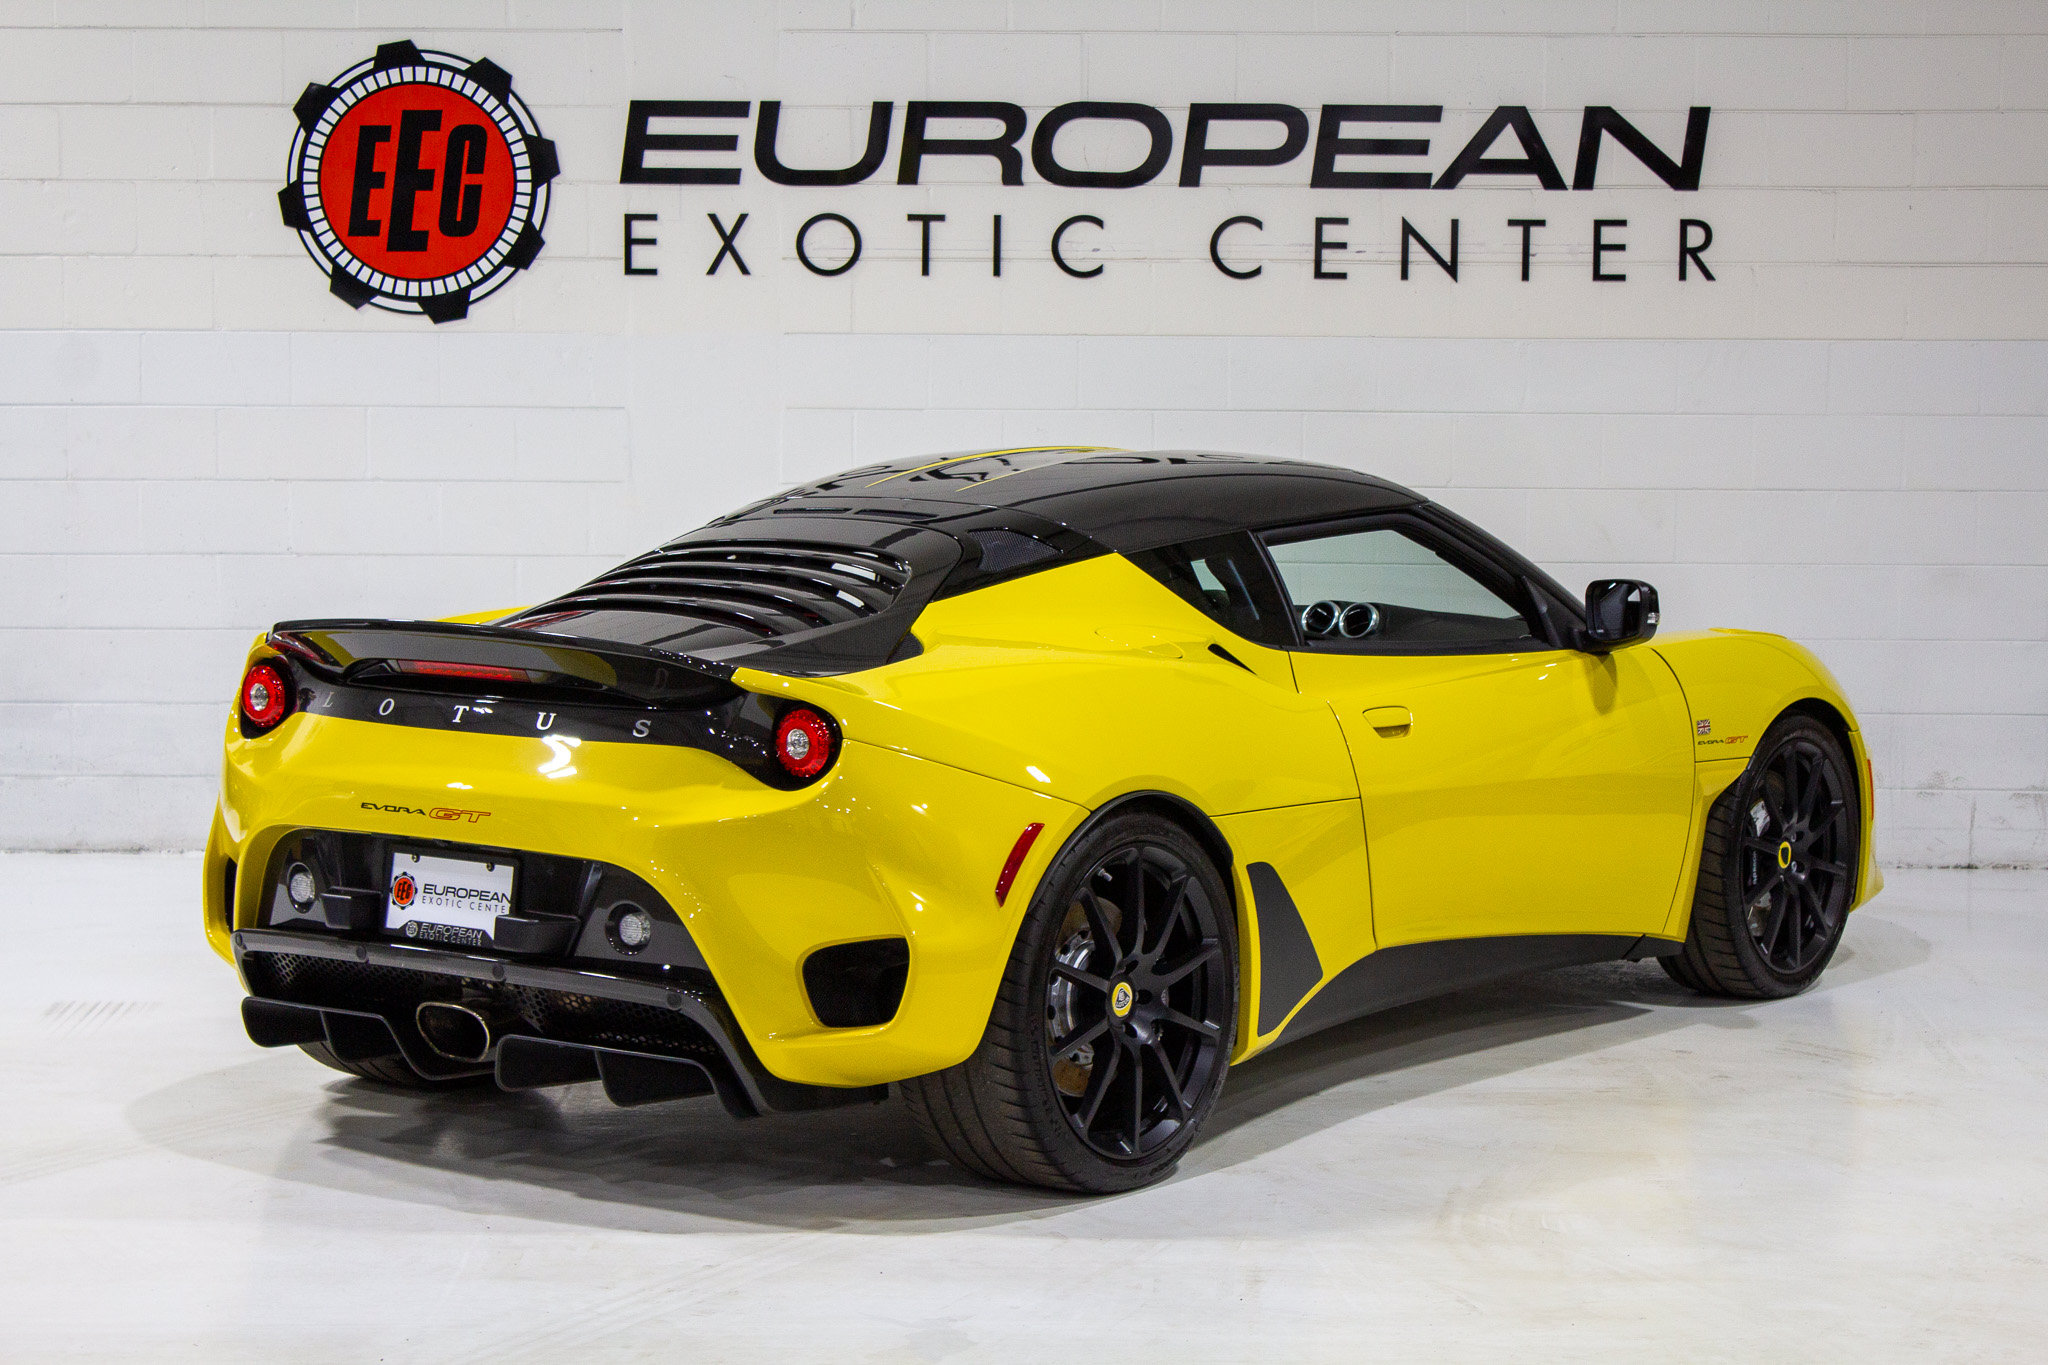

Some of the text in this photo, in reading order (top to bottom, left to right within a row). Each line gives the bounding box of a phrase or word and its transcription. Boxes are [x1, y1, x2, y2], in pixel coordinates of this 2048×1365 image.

[619, 100, 1712, 191] EUROPEAN
[347, 109, 488, 252] EEC
[624, 212, 1716, 284] EXOTIC CENTER
[321, 691, 652, 738] LOTUS
[1724, 735, 1749, 745] GT
[360, 801, 492, 824] EVORA GT
[396, 881, 412, 901] EEC
[423, 883, 511, 904] EUROPEAN
[422, 895, 506, 914] EXOTIC CENTE
[419, 931, 482, 947] EXOTIC CENTER
[420, 922, 483, 938] EUROPEAN
